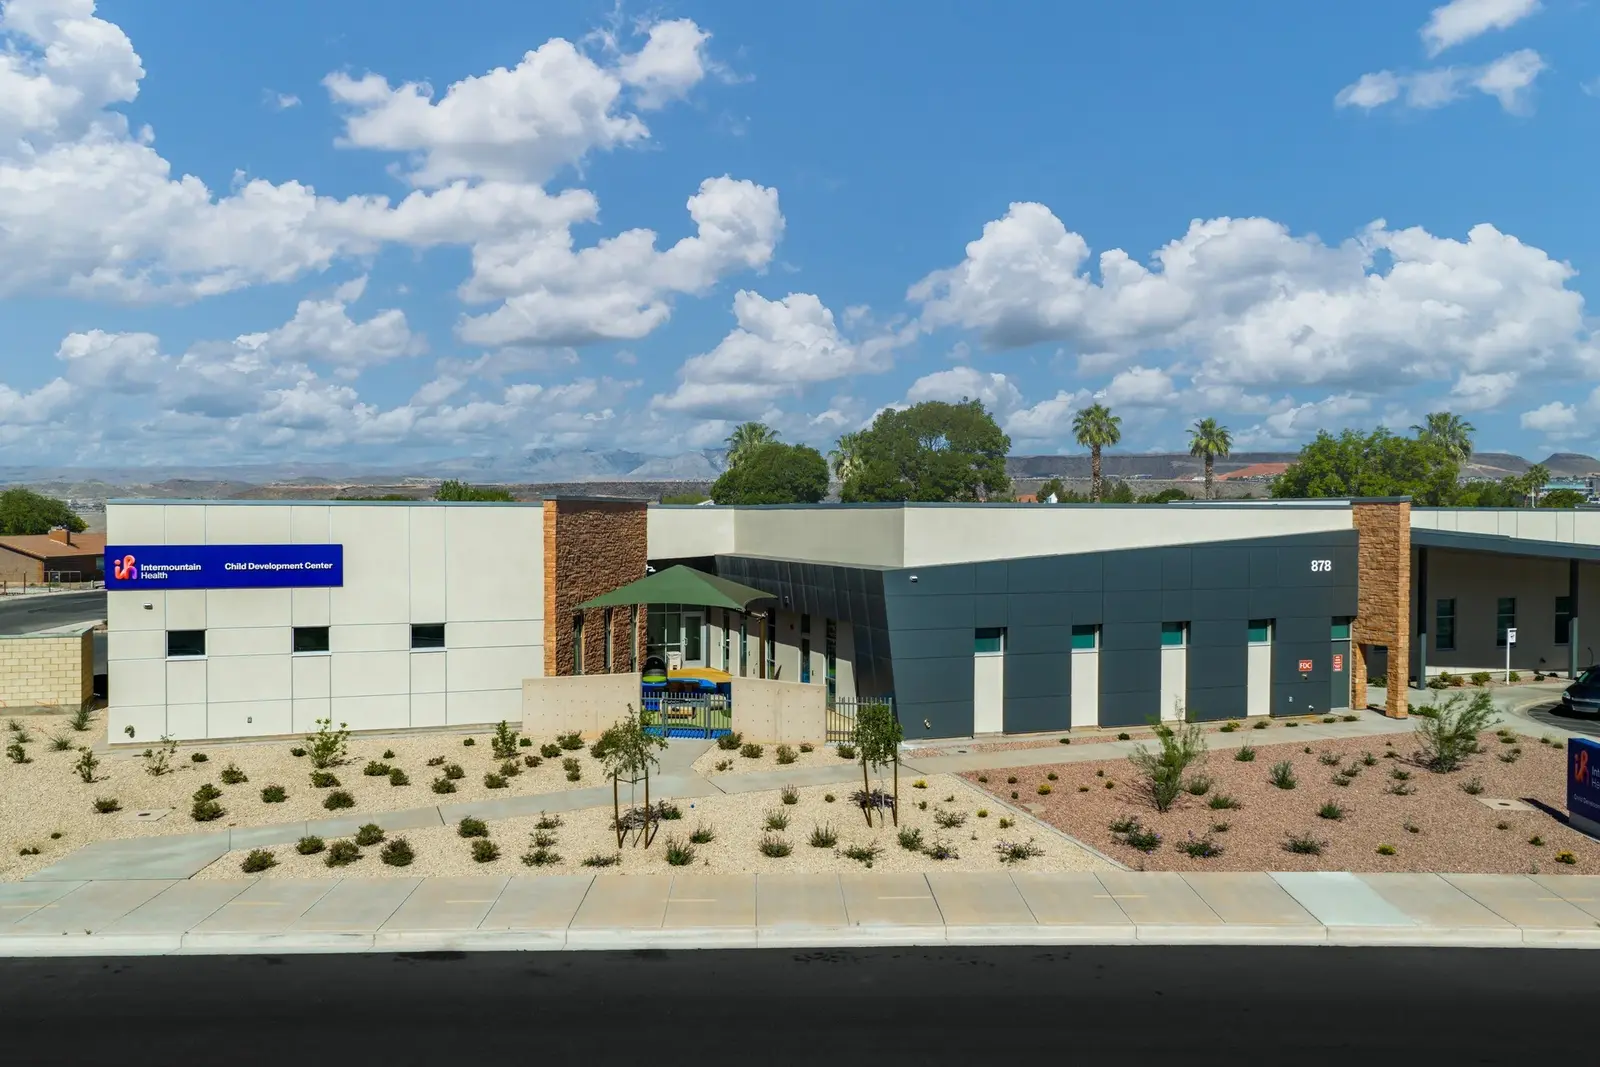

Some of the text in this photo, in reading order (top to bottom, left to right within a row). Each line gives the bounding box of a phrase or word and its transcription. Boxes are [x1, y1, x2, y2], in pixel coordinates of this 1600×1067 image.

[140, 563, 202, 571] Intermountain
[248, 562, 304, 571] Development
[1311, 560, 1331, 571] 878
[140, 571, 168, 579] Health
